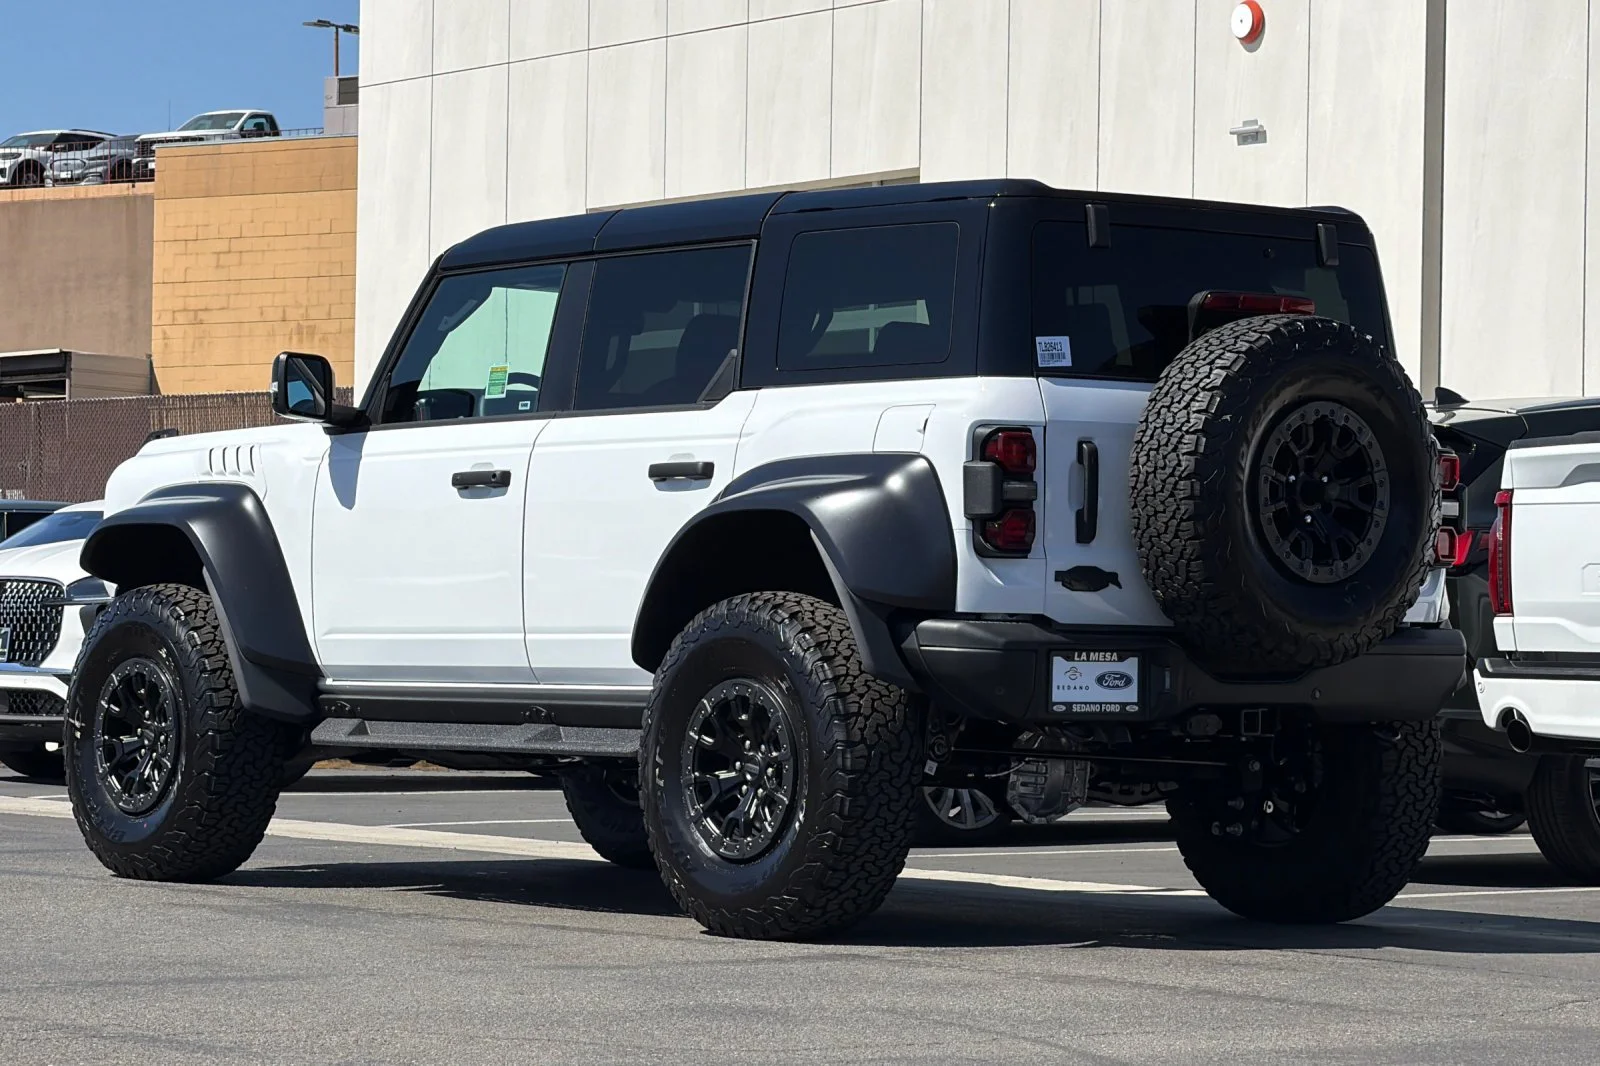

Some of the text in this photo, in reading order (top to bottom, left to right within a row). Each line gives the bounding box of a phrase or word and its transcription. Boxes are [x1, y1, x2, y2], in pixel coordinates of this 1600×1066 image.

[1074, 652, 1118, 661] LA MESA
[1072, 704, 1100, 712] SEDANO
[1102, 704, 1120, 712] FORD
